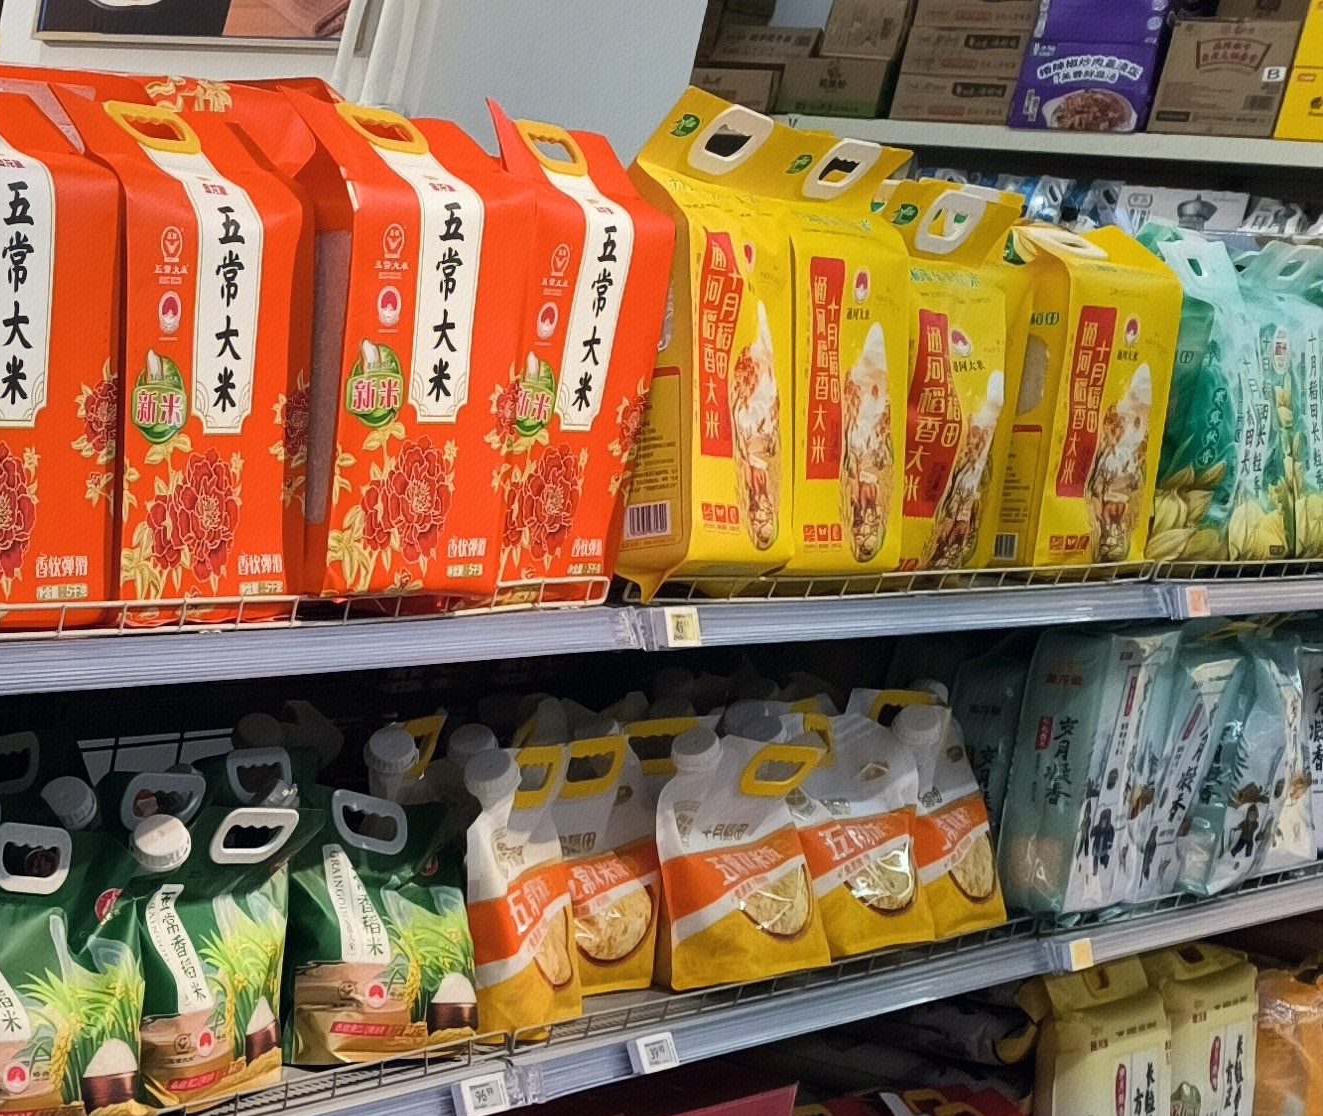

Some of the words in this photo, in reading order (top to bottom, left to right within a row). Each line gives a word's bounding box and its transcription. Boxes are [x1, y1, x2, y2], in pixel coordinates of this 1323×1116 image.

[0, 181, 35, 405] 五常大米
[214, 205, 245, 413] 五常大米
[427, 201, 464, 403] 五常大米
[571, 226, 618, 411] 五常大米
[136, 389, 182, 423] 新米
[352, 381, 400, 410] 新米
